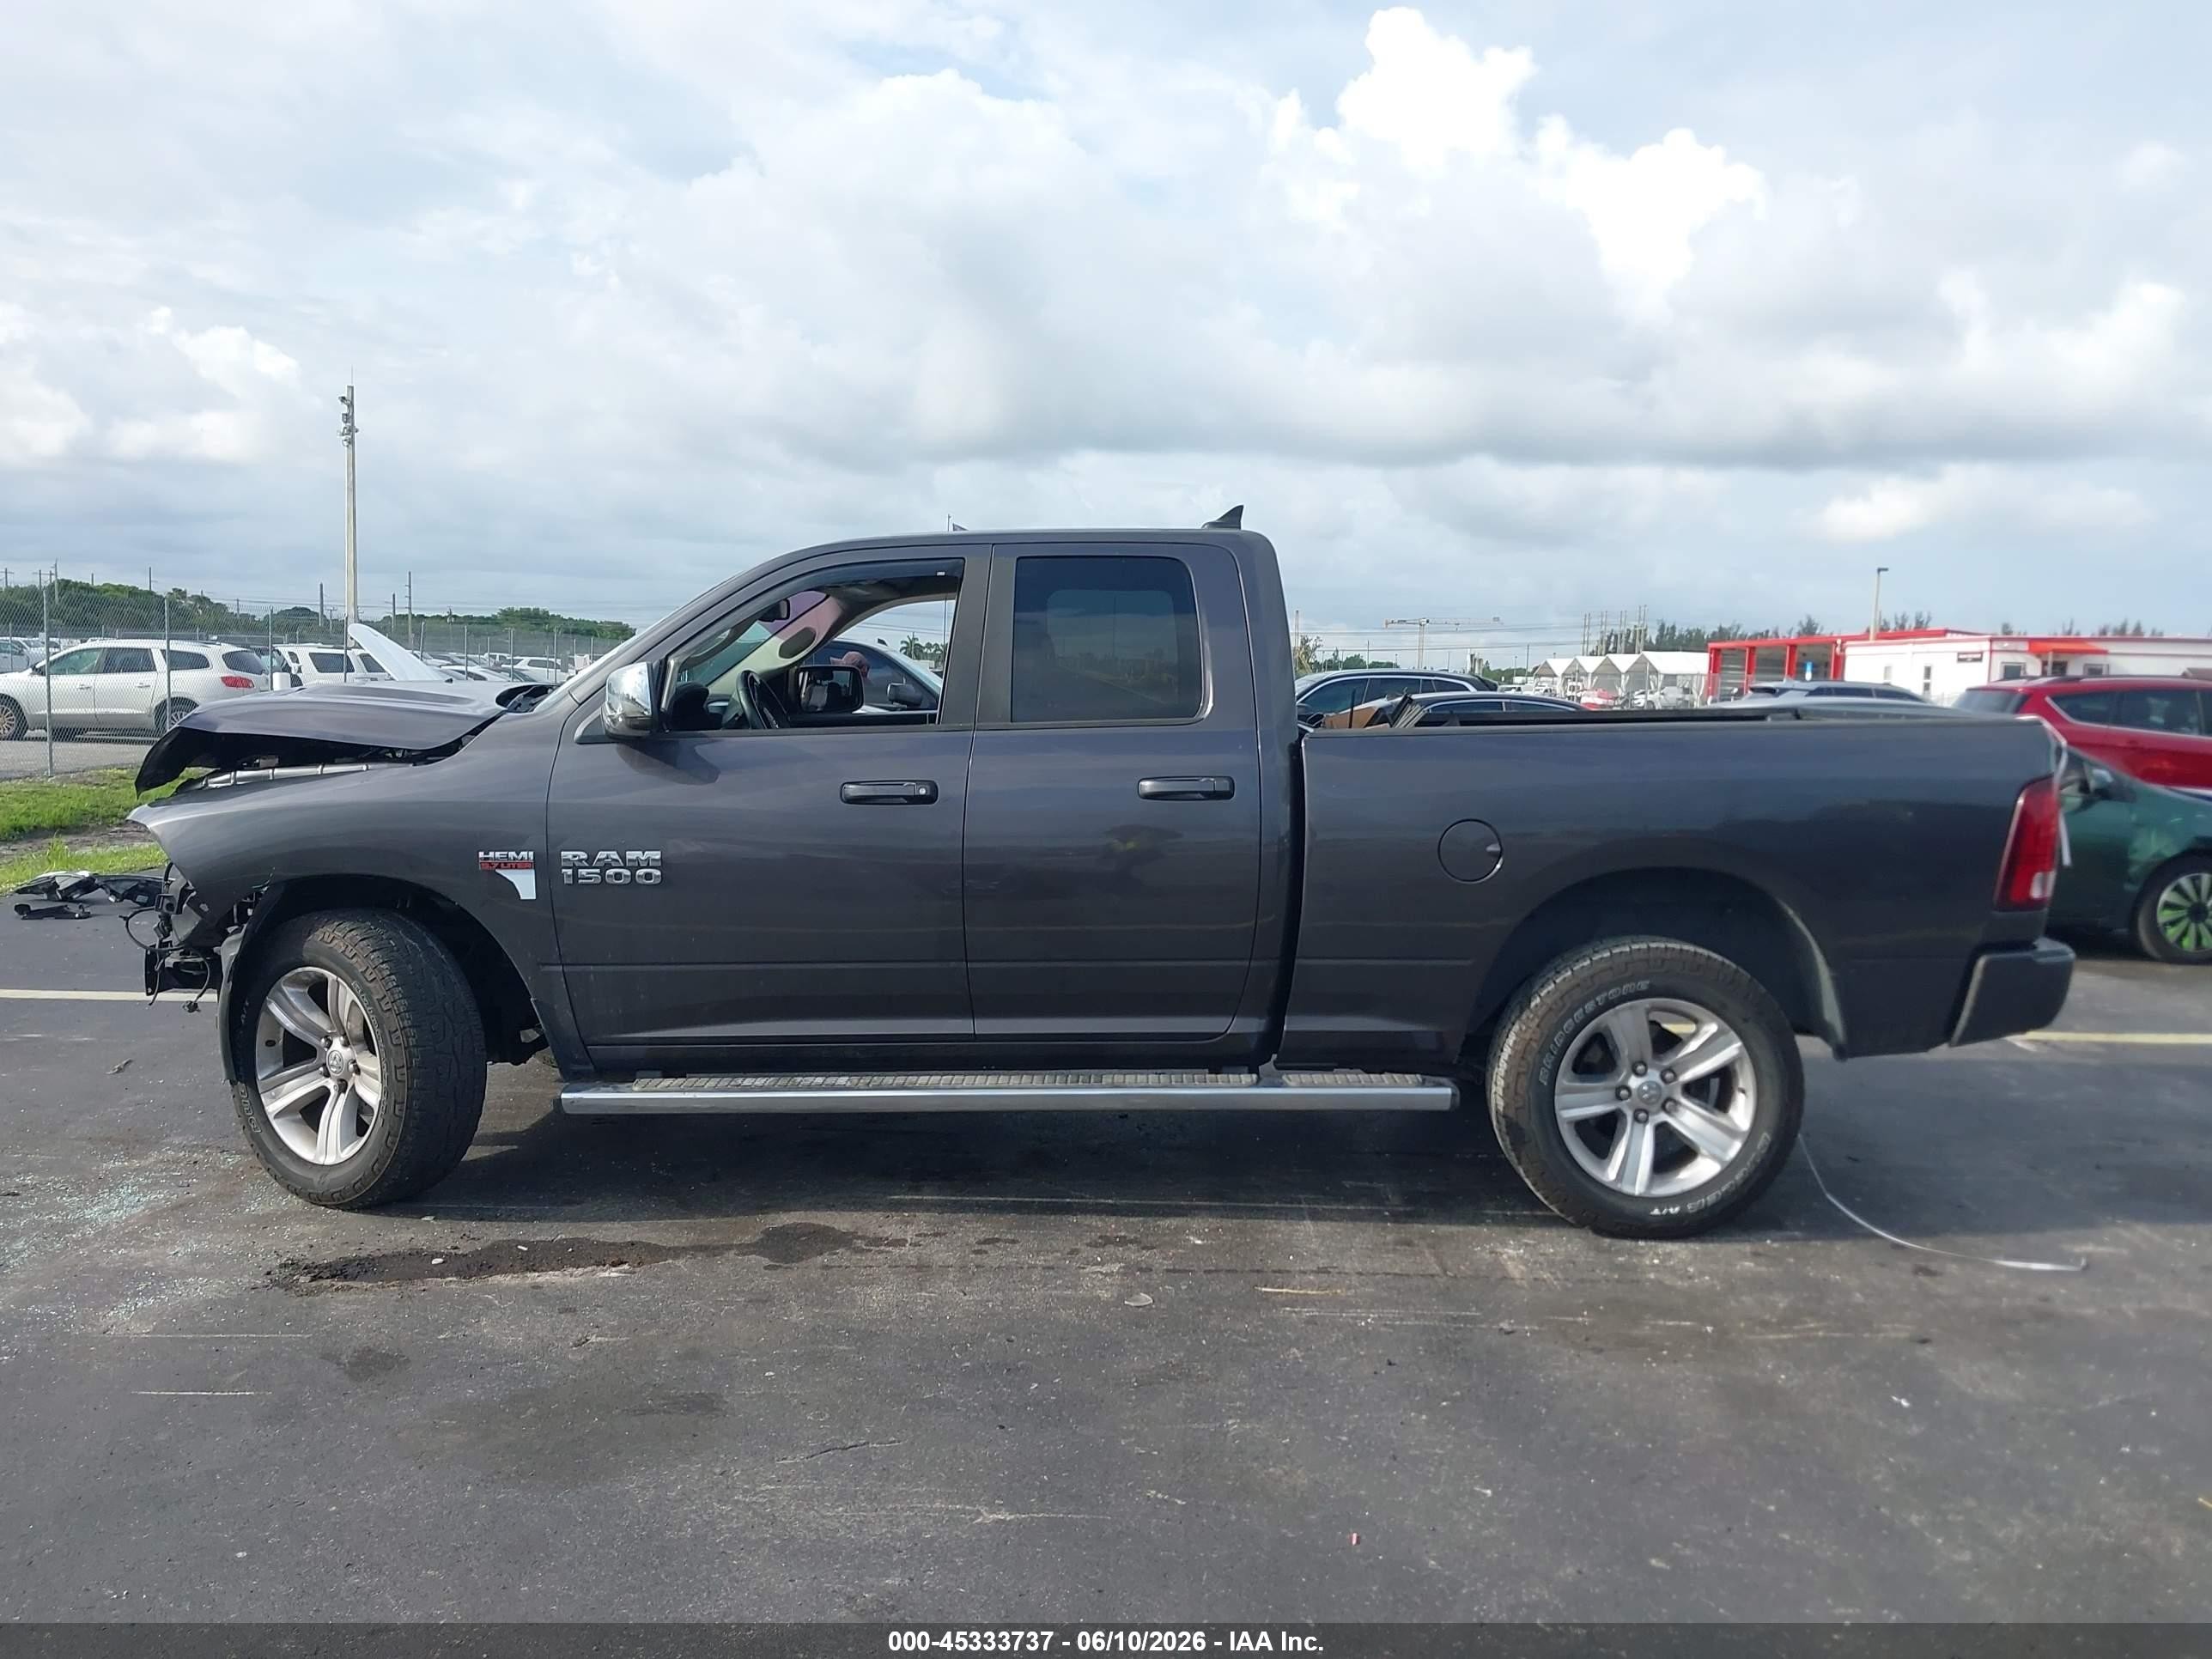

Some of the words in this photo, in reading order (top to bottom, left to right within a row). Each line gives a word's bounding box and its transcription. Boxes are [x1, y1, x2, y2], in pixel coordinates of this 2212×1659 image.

[478, 851, 534, 861] HEMI
[561, 850, 661, 866] RAM
[561, 868, 662, 885] 1500
[1538, 980, 1650, 1085] BRIDGESTONE
